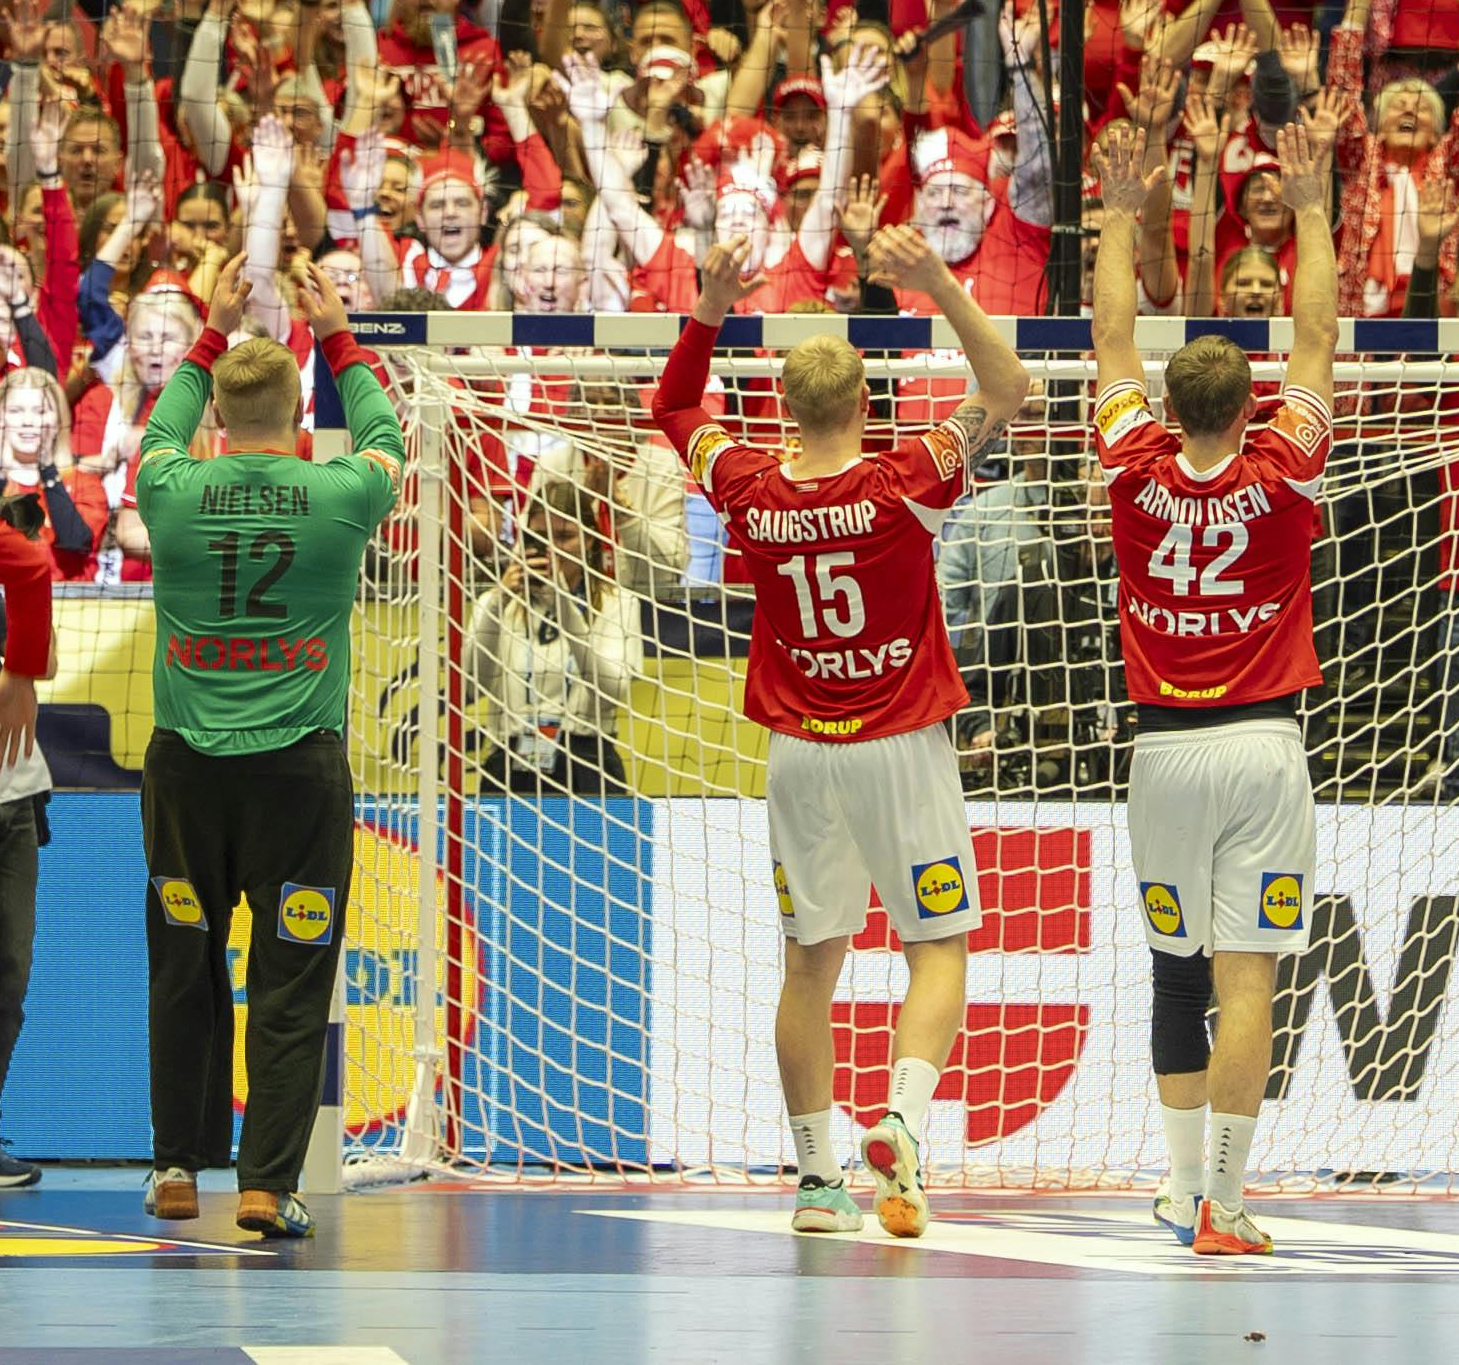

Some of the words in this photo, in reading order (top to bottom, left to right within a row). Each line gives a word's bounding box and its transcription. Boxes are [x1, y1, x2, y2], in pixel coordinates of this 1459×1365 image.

[197, 484, 310, 517] NIELSEN
[746, 499, 877, 544] SAUGSTRUP
[208, 530, 297, 620] 12
[1147, 523, 1250, 597] 42
[776, 551, 867, 639] 15
[165, 633, 329, 672] NORLYS
[791, 637, 913, 680] ORLYS
[1159, 681, 1228, 699] BORUP
[801, 715, 863, 735] BORUP
